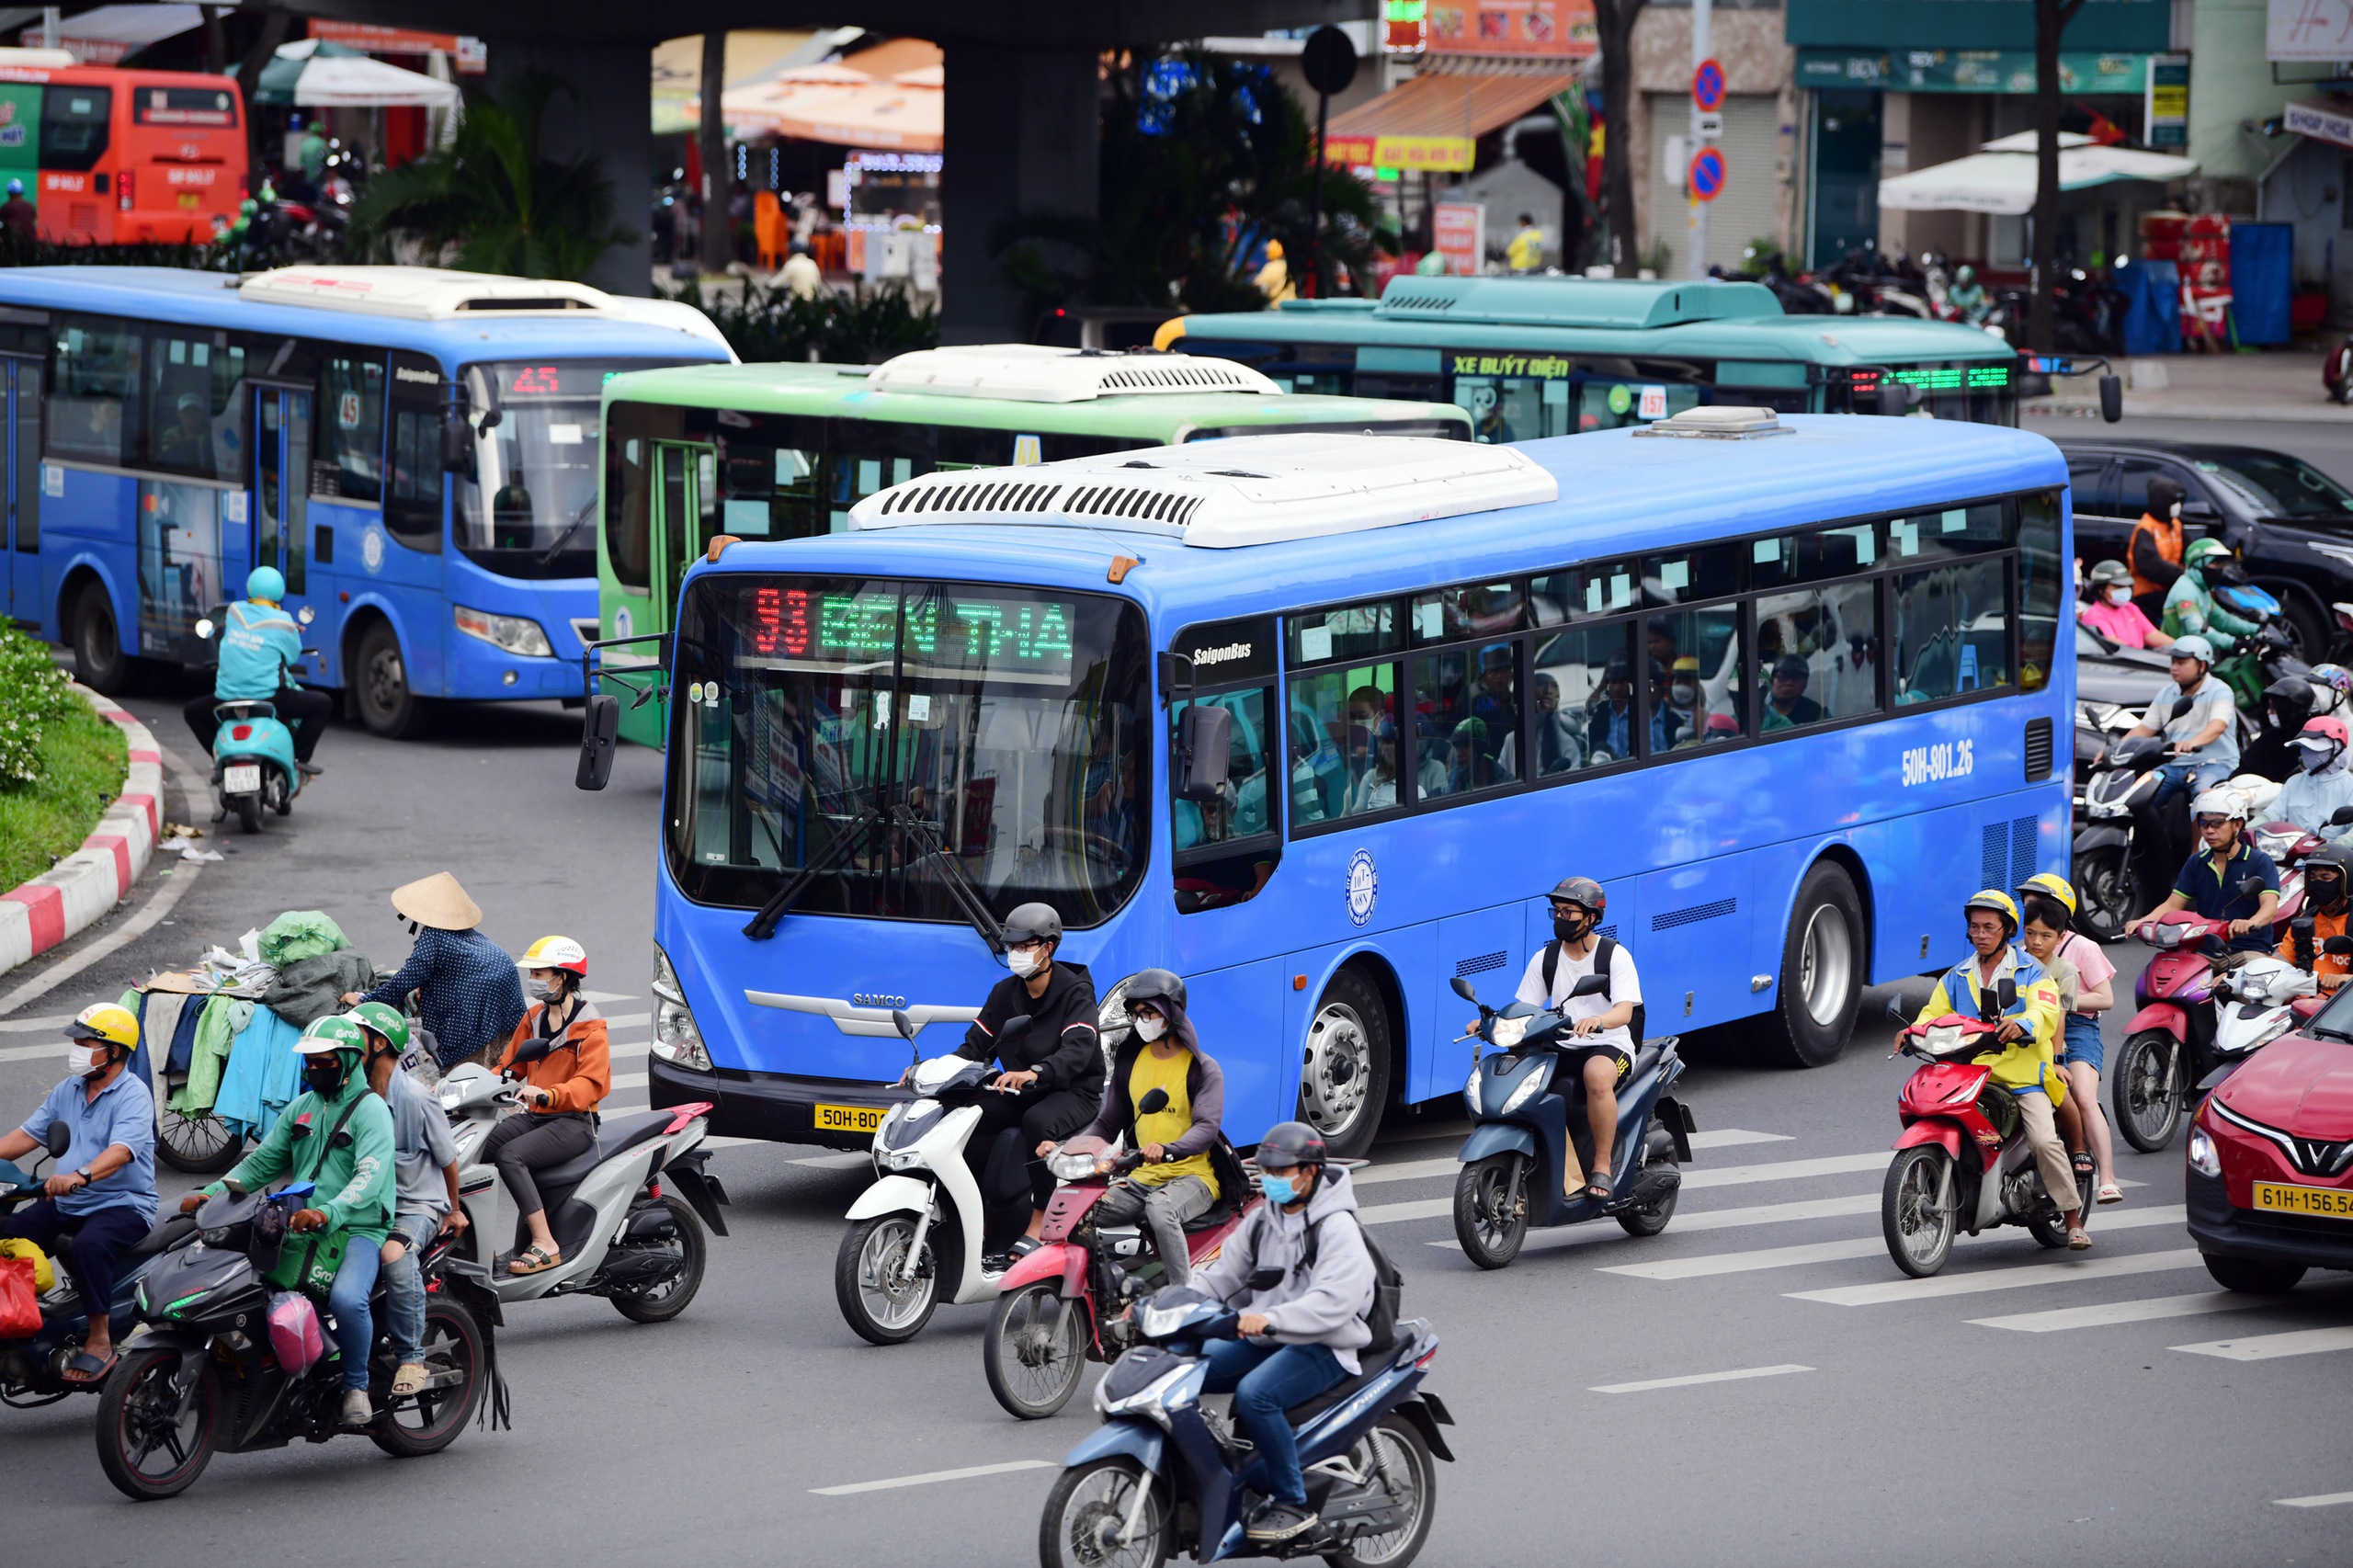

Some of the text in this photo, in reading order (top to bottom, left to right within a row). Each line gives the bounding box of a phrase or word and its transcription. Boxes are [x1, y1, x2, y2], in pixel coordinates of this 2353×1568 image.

[1453, 356, 1477, 374] XE
[1479, 354, 1528, 376] BUÝT
[342, 394, 358, 424] 45
[1643, 395, 1665, 414] 157
[757, 589, 808, 653] 93
[1193, 643, 1251, 665] SaigonBus
[1902, 739, 1973, 787] 50H-801.26
[853, 993, 906, 1008] SAMCO
[376, 1012, 402, 1032] Grab
[335, 1028, 360, 1040] Grab
[823, 1108, 884, 1130] 50H-80
[631, 1139, 664, 1158] VISION
[464, 1175, 492, 1187] SPORT
